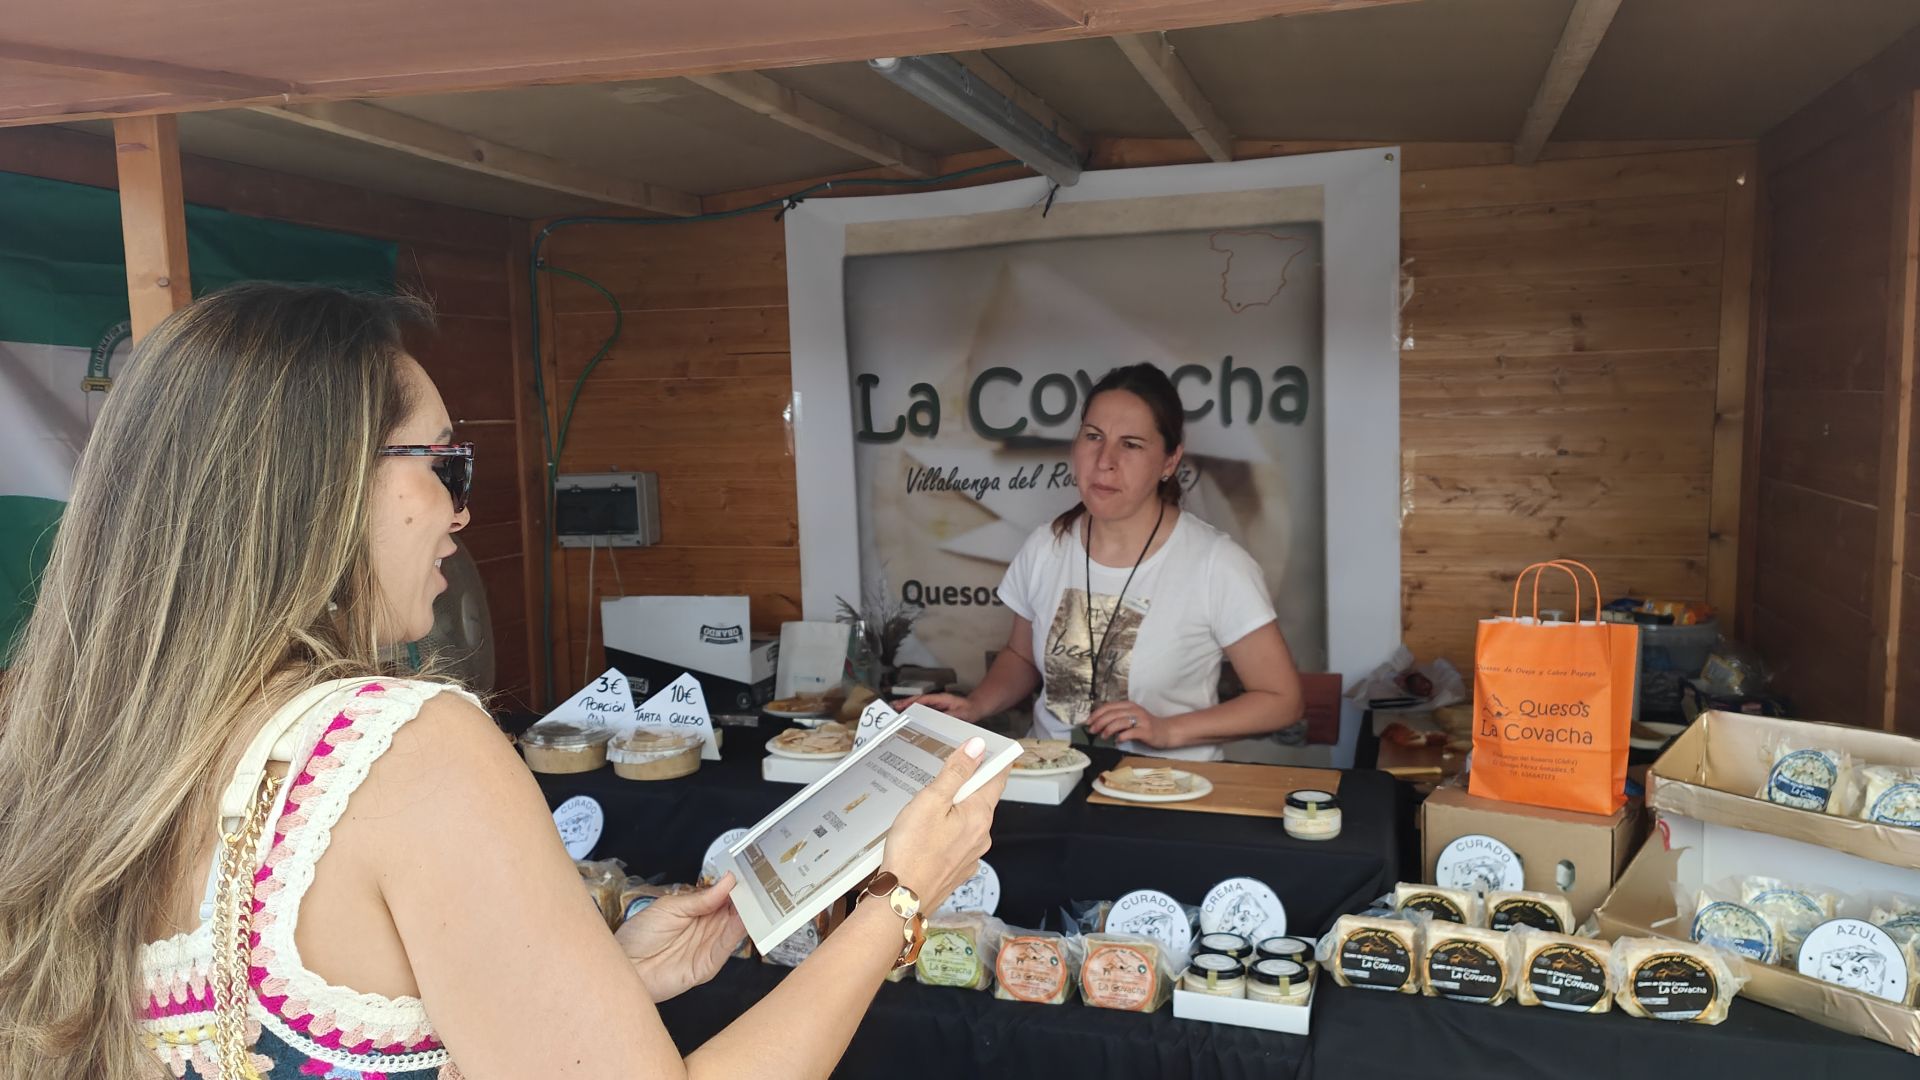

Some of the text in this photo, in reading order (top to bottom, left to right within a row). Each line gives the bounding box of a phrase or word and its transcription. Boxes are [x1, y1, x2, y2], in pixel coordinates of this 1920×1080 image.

[857, 355, 1311, 443] La Cocha
[906, 466, 1000, 500] Villaluenga
[1008, 464, 1044, 490] del
[902, 579, 1004, 608] Quesos
[596, 676, 623, 695] 3€
[670, 684, 697, 705] 10€
[634, 708, 704, 727] TARTA QUESO
[861, 706, 890, 730] 5€
[1481, 720, 1593, 745] La Covacha
[560, 799, 597, 815] CURADO
[1455, 839, 1511, 863] CURADO
[1121, 894, 1177, 914] CURADO
[1204, 882, 1245, 914] CREMA
[1836, 924, 1878, 946] AZUL
[1658, 985, 1708, 995] La Covacha
